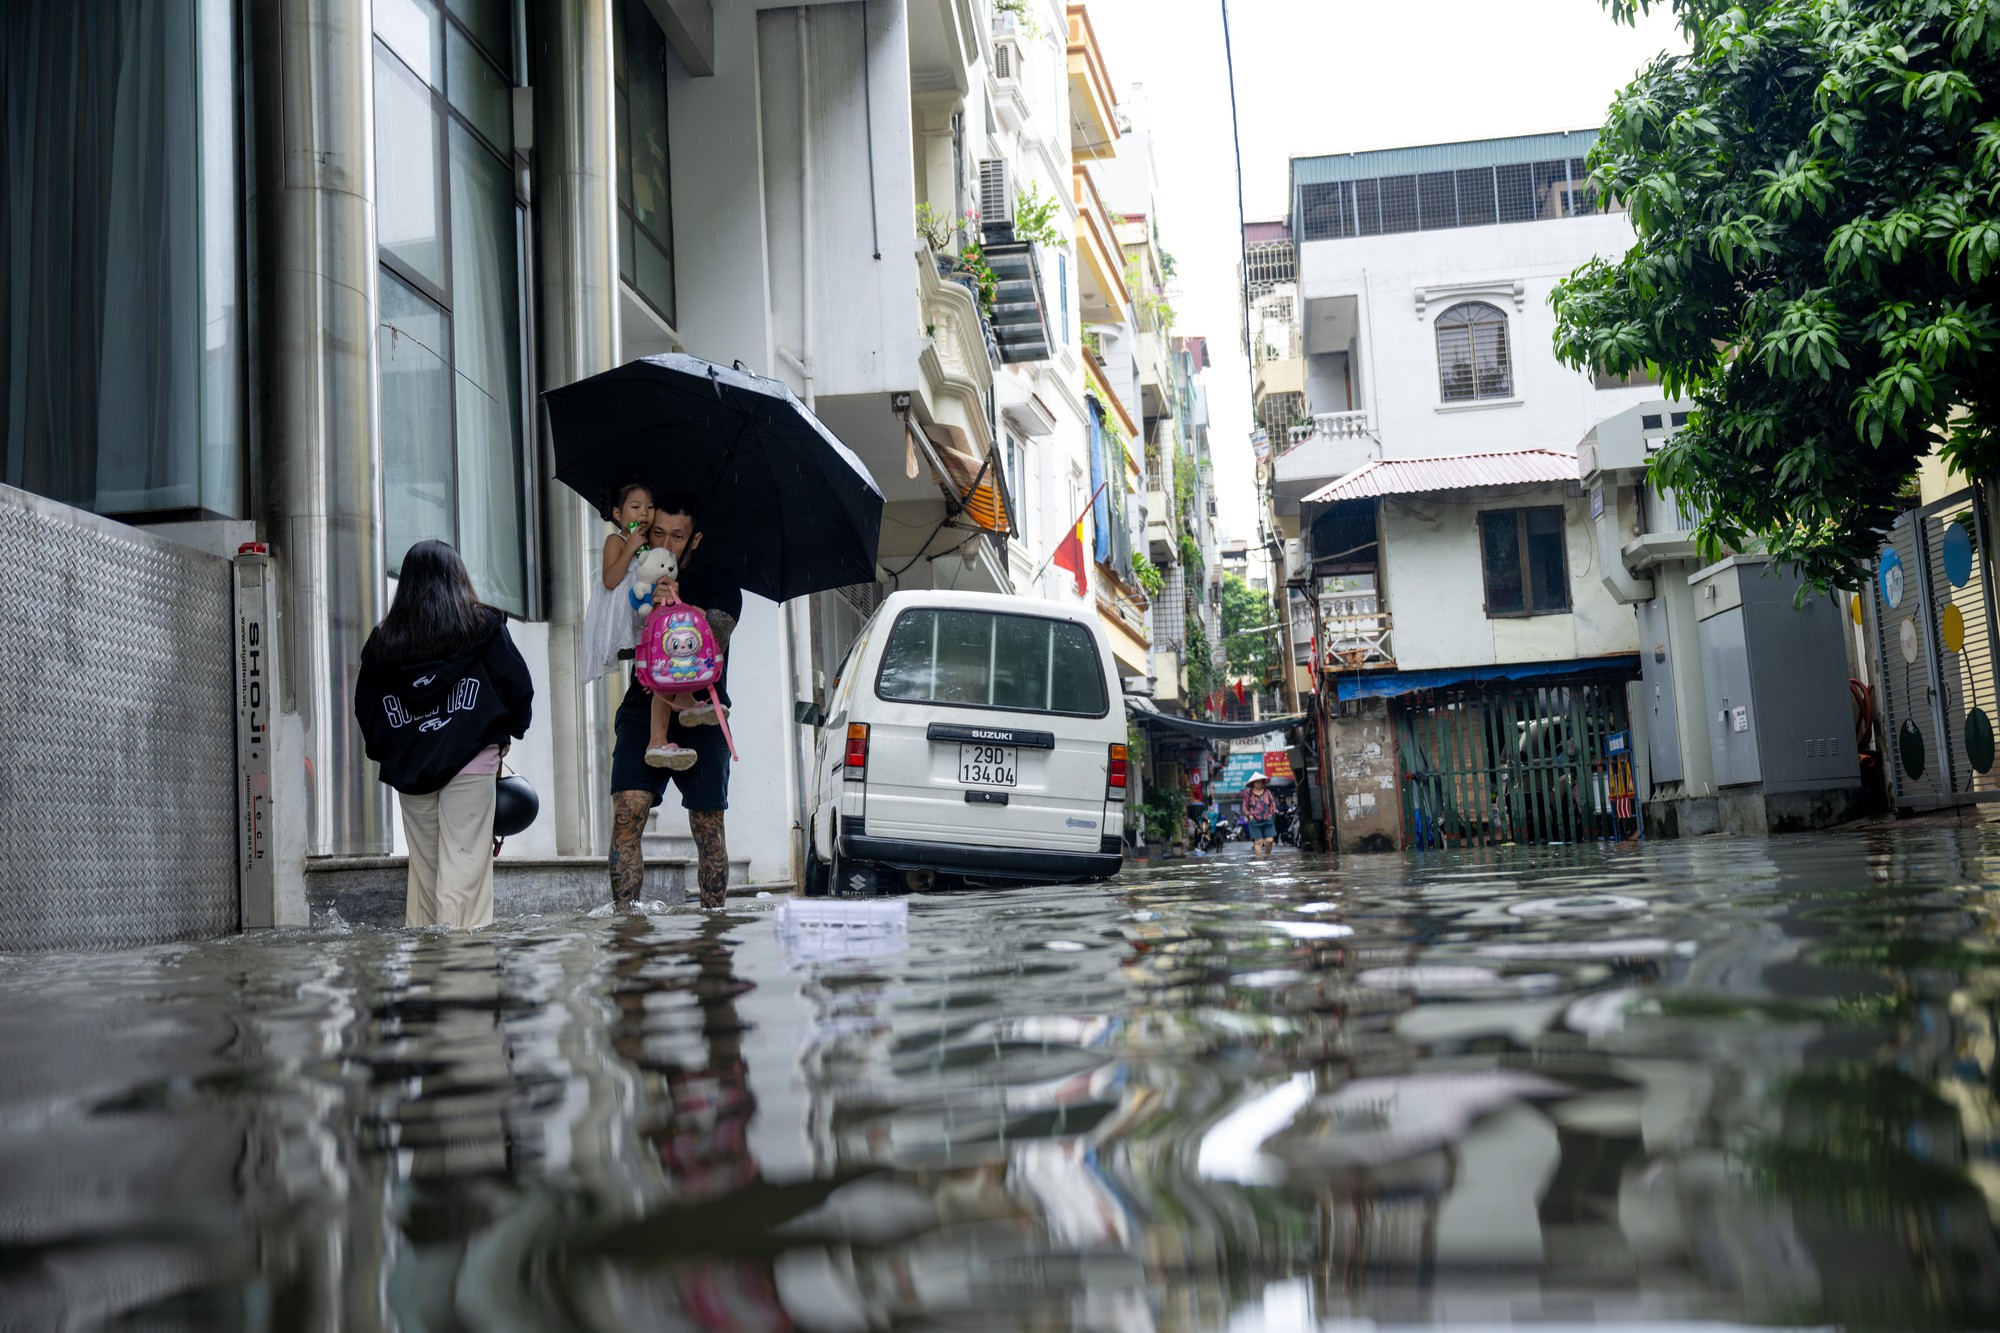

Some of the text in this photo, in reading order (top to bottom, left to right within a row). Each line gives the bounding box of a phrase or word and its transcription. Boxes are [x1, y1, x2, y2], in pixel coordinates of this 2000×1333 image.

[971, 730, 1013, 740] SUZUKI
[974, 746, 1004, 765] 29D
[963, 764, 1015, 784] 134.04
